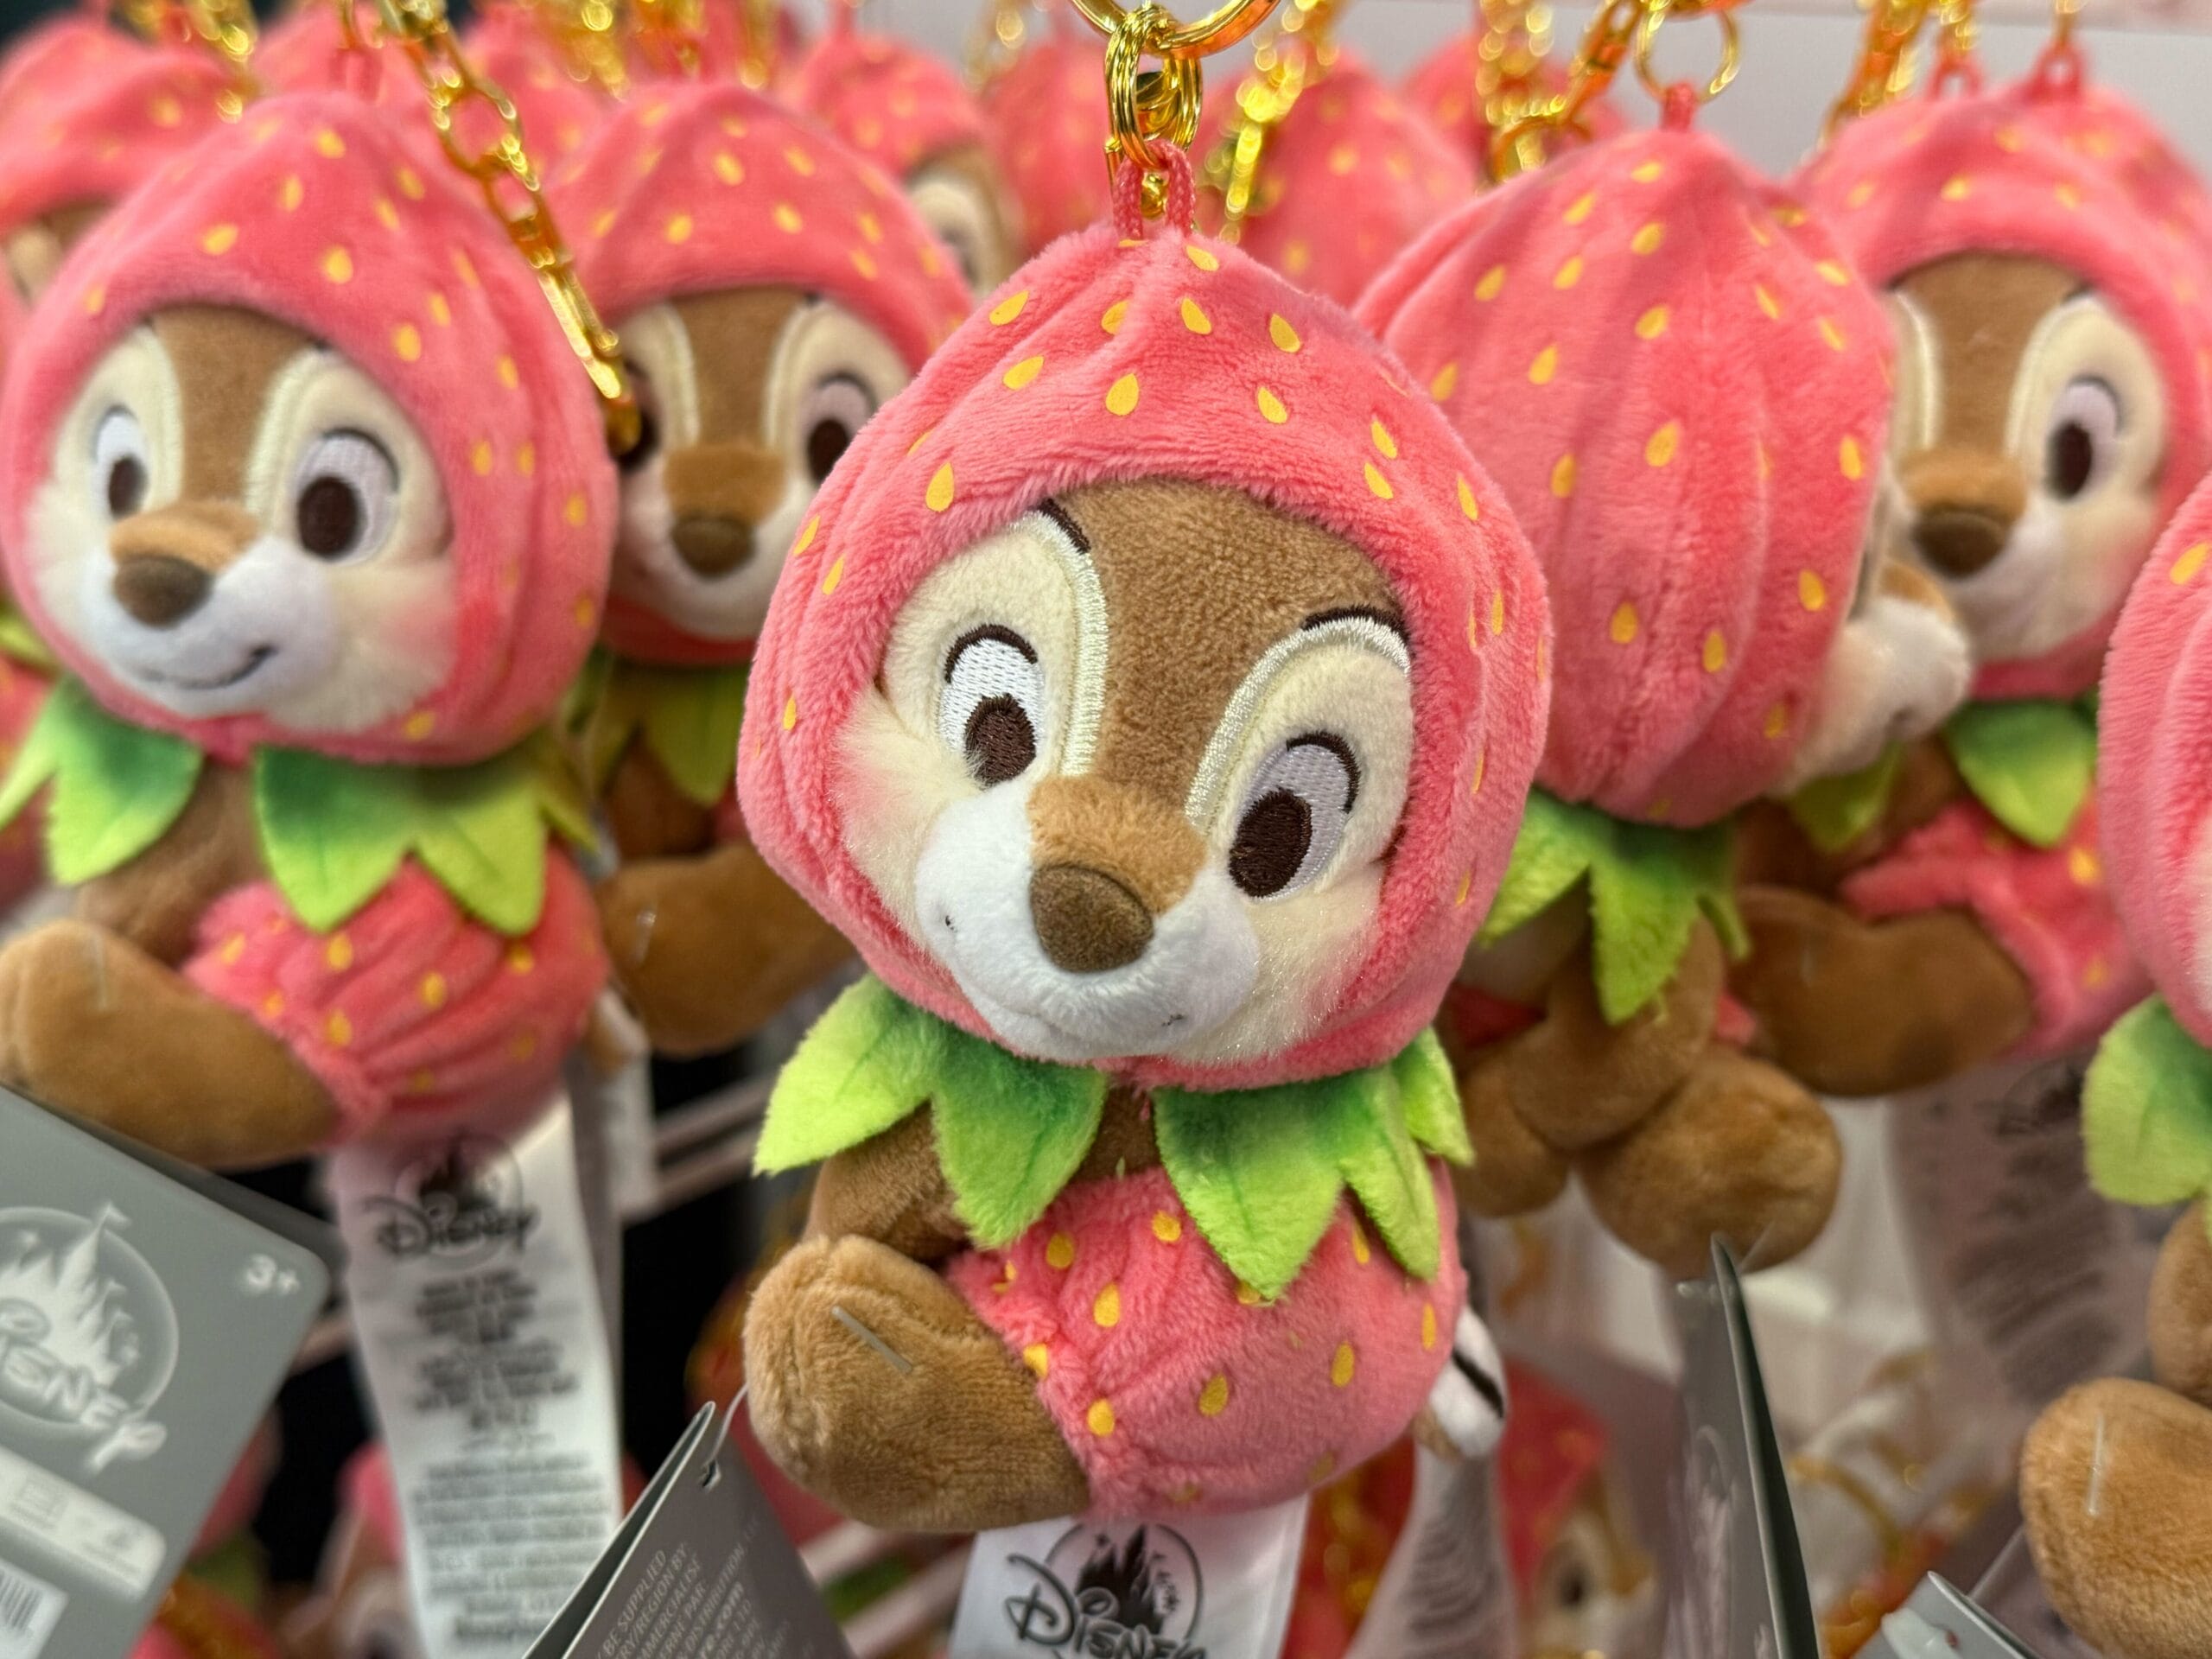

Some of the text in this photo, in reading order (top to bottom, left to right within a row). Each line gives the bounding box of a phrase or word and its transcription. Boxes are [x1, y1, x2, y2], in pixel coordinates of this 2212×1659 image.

[246, 1253, 302, 1294] 3+
[670, 1541, 687, 1571] BY
[601, 1549, 665, 1657] BE SUPPLIED
[683, 1542, 746, 1651] DISTRIBUTION
[683, 1581, 705, 1618] PAR
